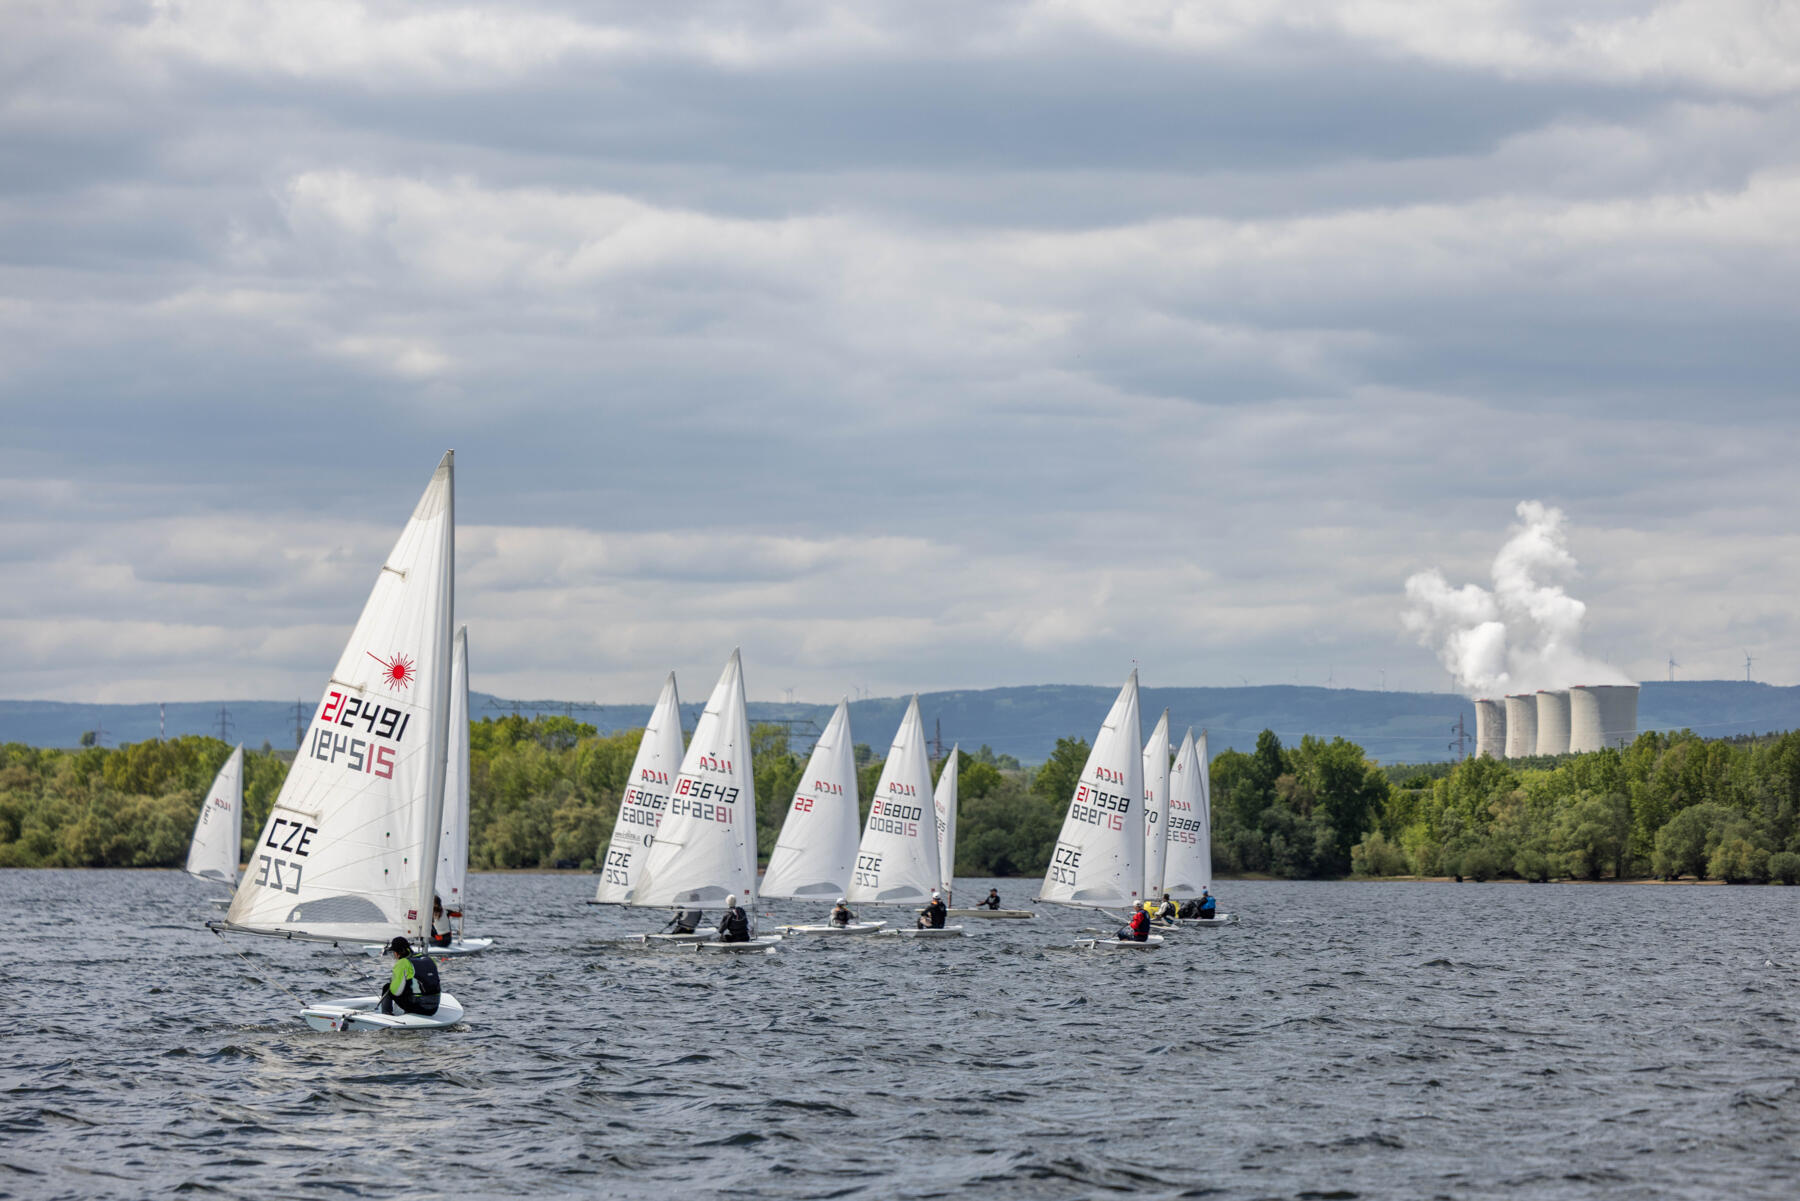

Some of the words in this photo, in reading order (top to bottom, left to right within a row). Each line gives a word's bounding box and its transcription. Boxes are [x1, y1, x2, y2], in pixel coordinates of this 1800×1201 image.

[321, 691, 411, 742] 212491
[674, 778, 740, 804] 185643
[1076, 786, 1130, 813] 217958
[873, 800, 922, 821] 216800
[1168, 816, 1200, 832] 3388
[266, 818, 318, 857] CZE
[607, 851, 632, 868] CZE
[858, 856, 882, 872] CZE
[1055, 847, 1082, 868] CZE
